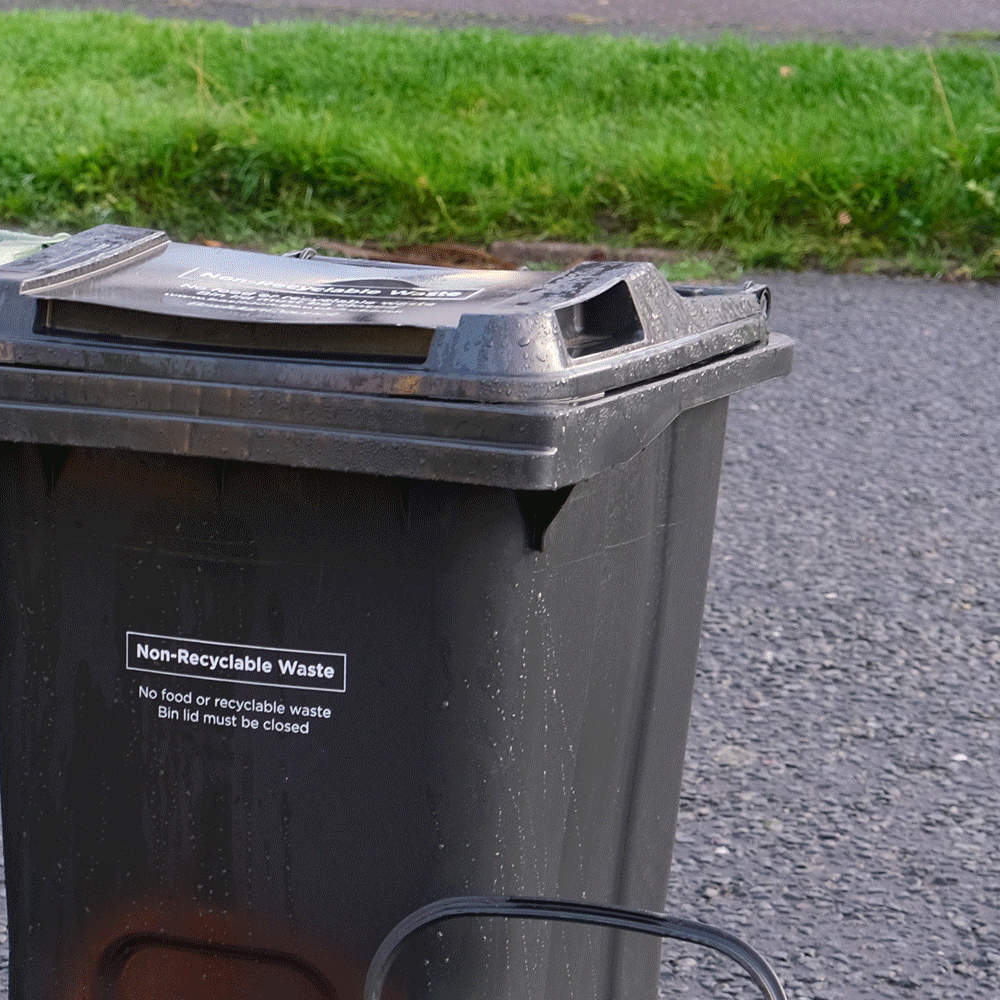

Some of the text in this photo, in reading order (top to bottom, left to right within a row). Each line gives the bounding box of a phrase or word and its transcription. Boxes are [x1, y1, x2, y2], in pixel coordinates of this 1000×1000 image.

[390, 289, 463, 297] Waste
[136, 643, 335, 679] Non-Recyclable Waste
[138, 686, 332, 719] No food or recyclable waste
[158, 706, 310, 734] Bin lid must be closed
